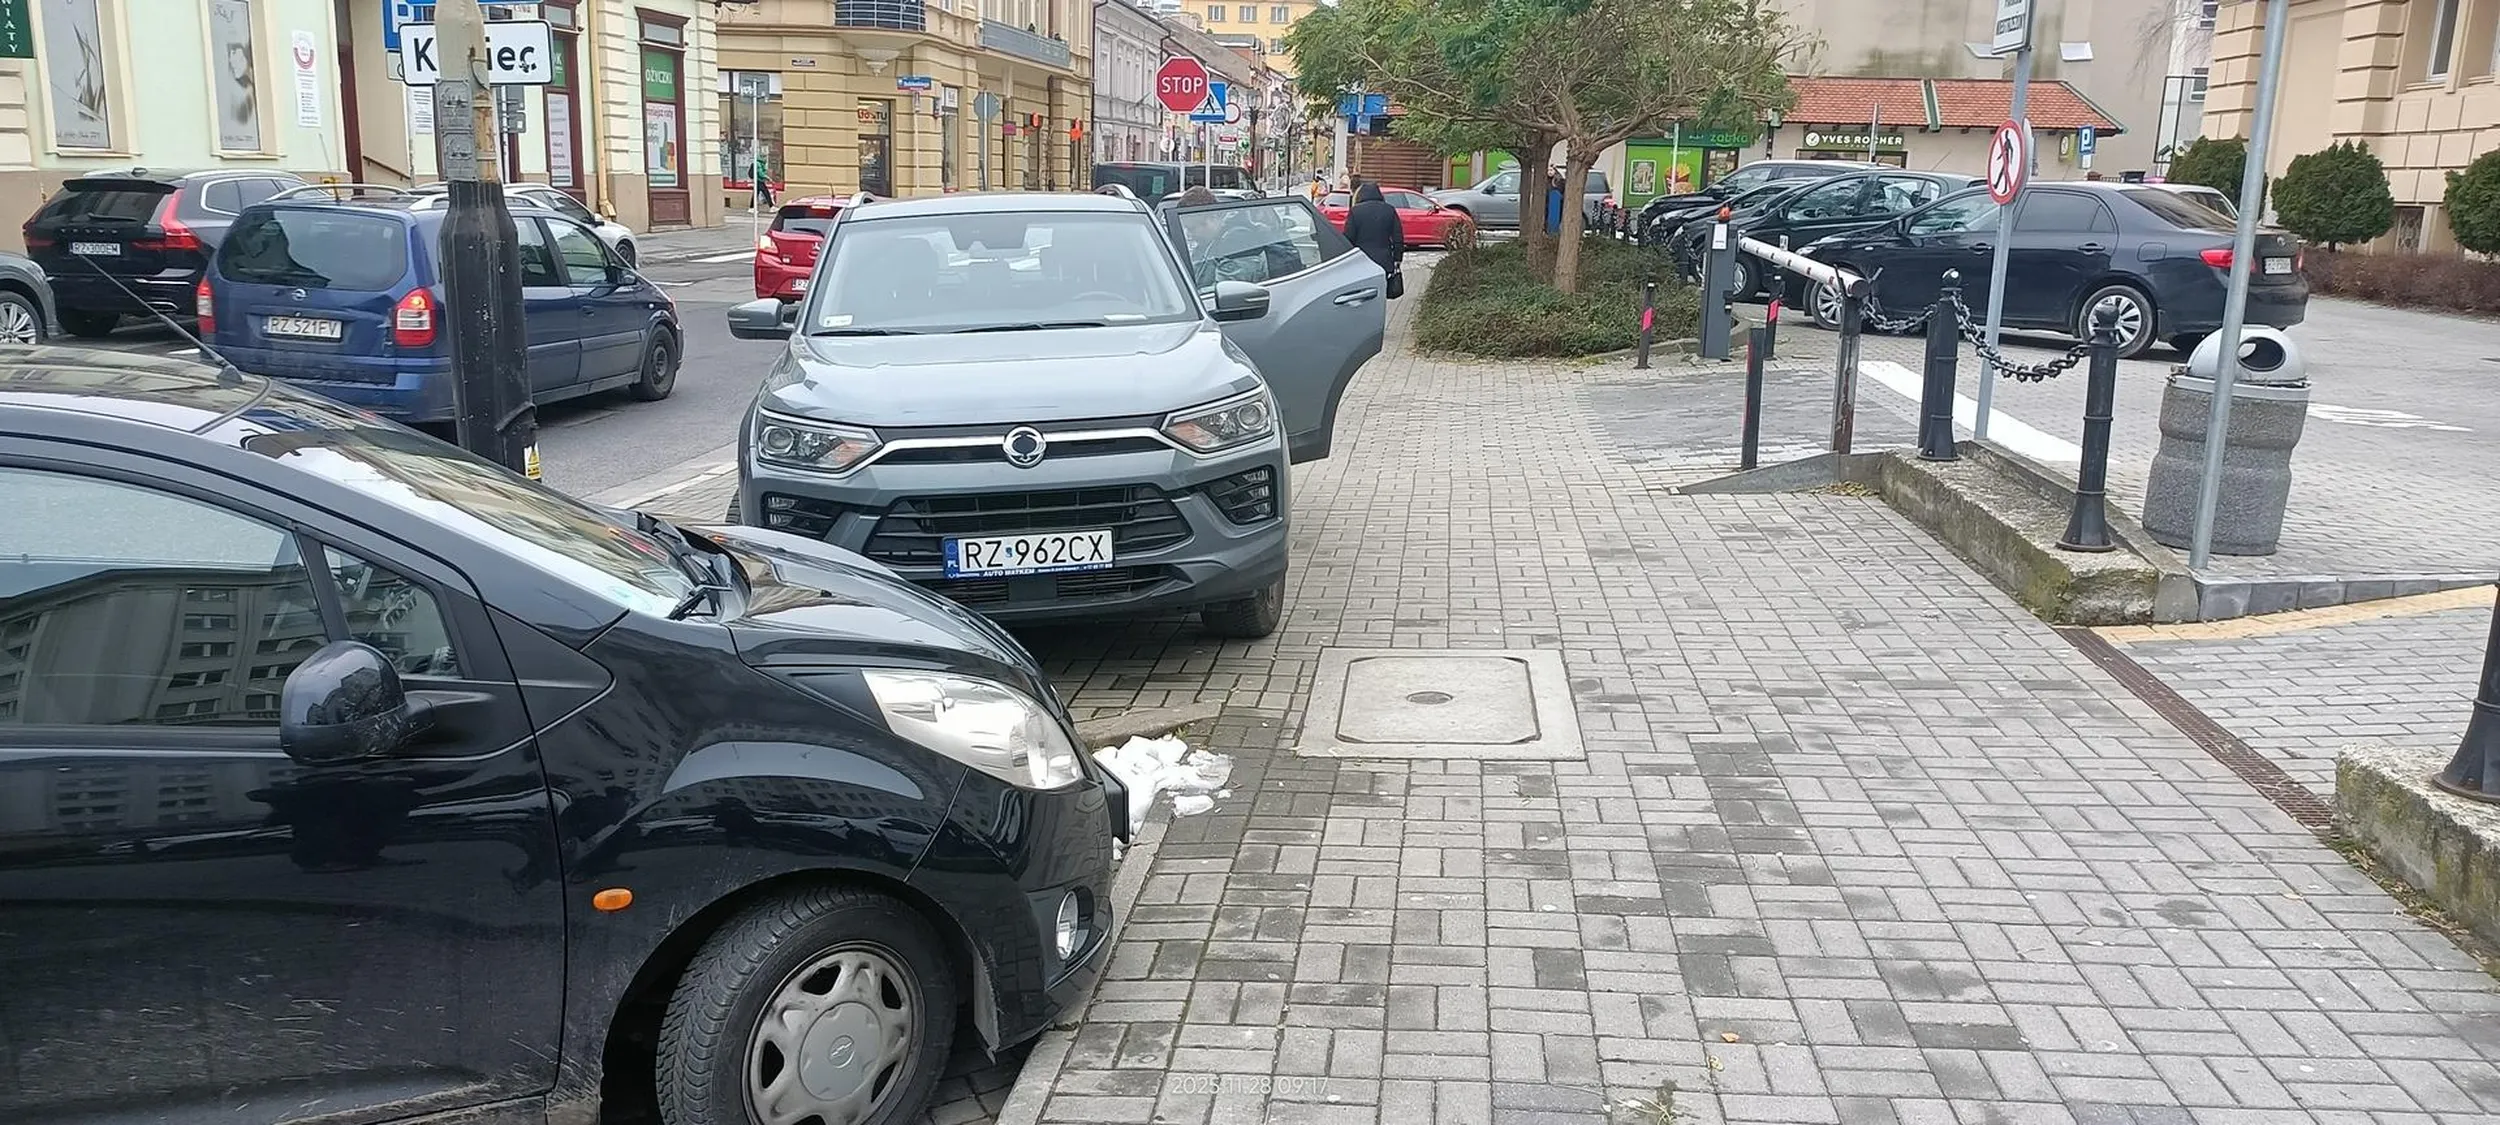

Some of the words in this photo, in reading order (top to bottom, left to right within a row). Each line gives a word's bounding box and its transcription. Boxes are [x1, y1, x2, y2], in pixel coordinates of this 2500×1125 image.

[413, 37, 537, 73] Kiec
[1161, 77, 1203, 93] STOP
[1821, 135, 1851, 144] YVES
[271, 318, 289, 332] RZ
[965, 540, 1003, 569] RZ
[1015, 534, 1104, 566] 962CX
